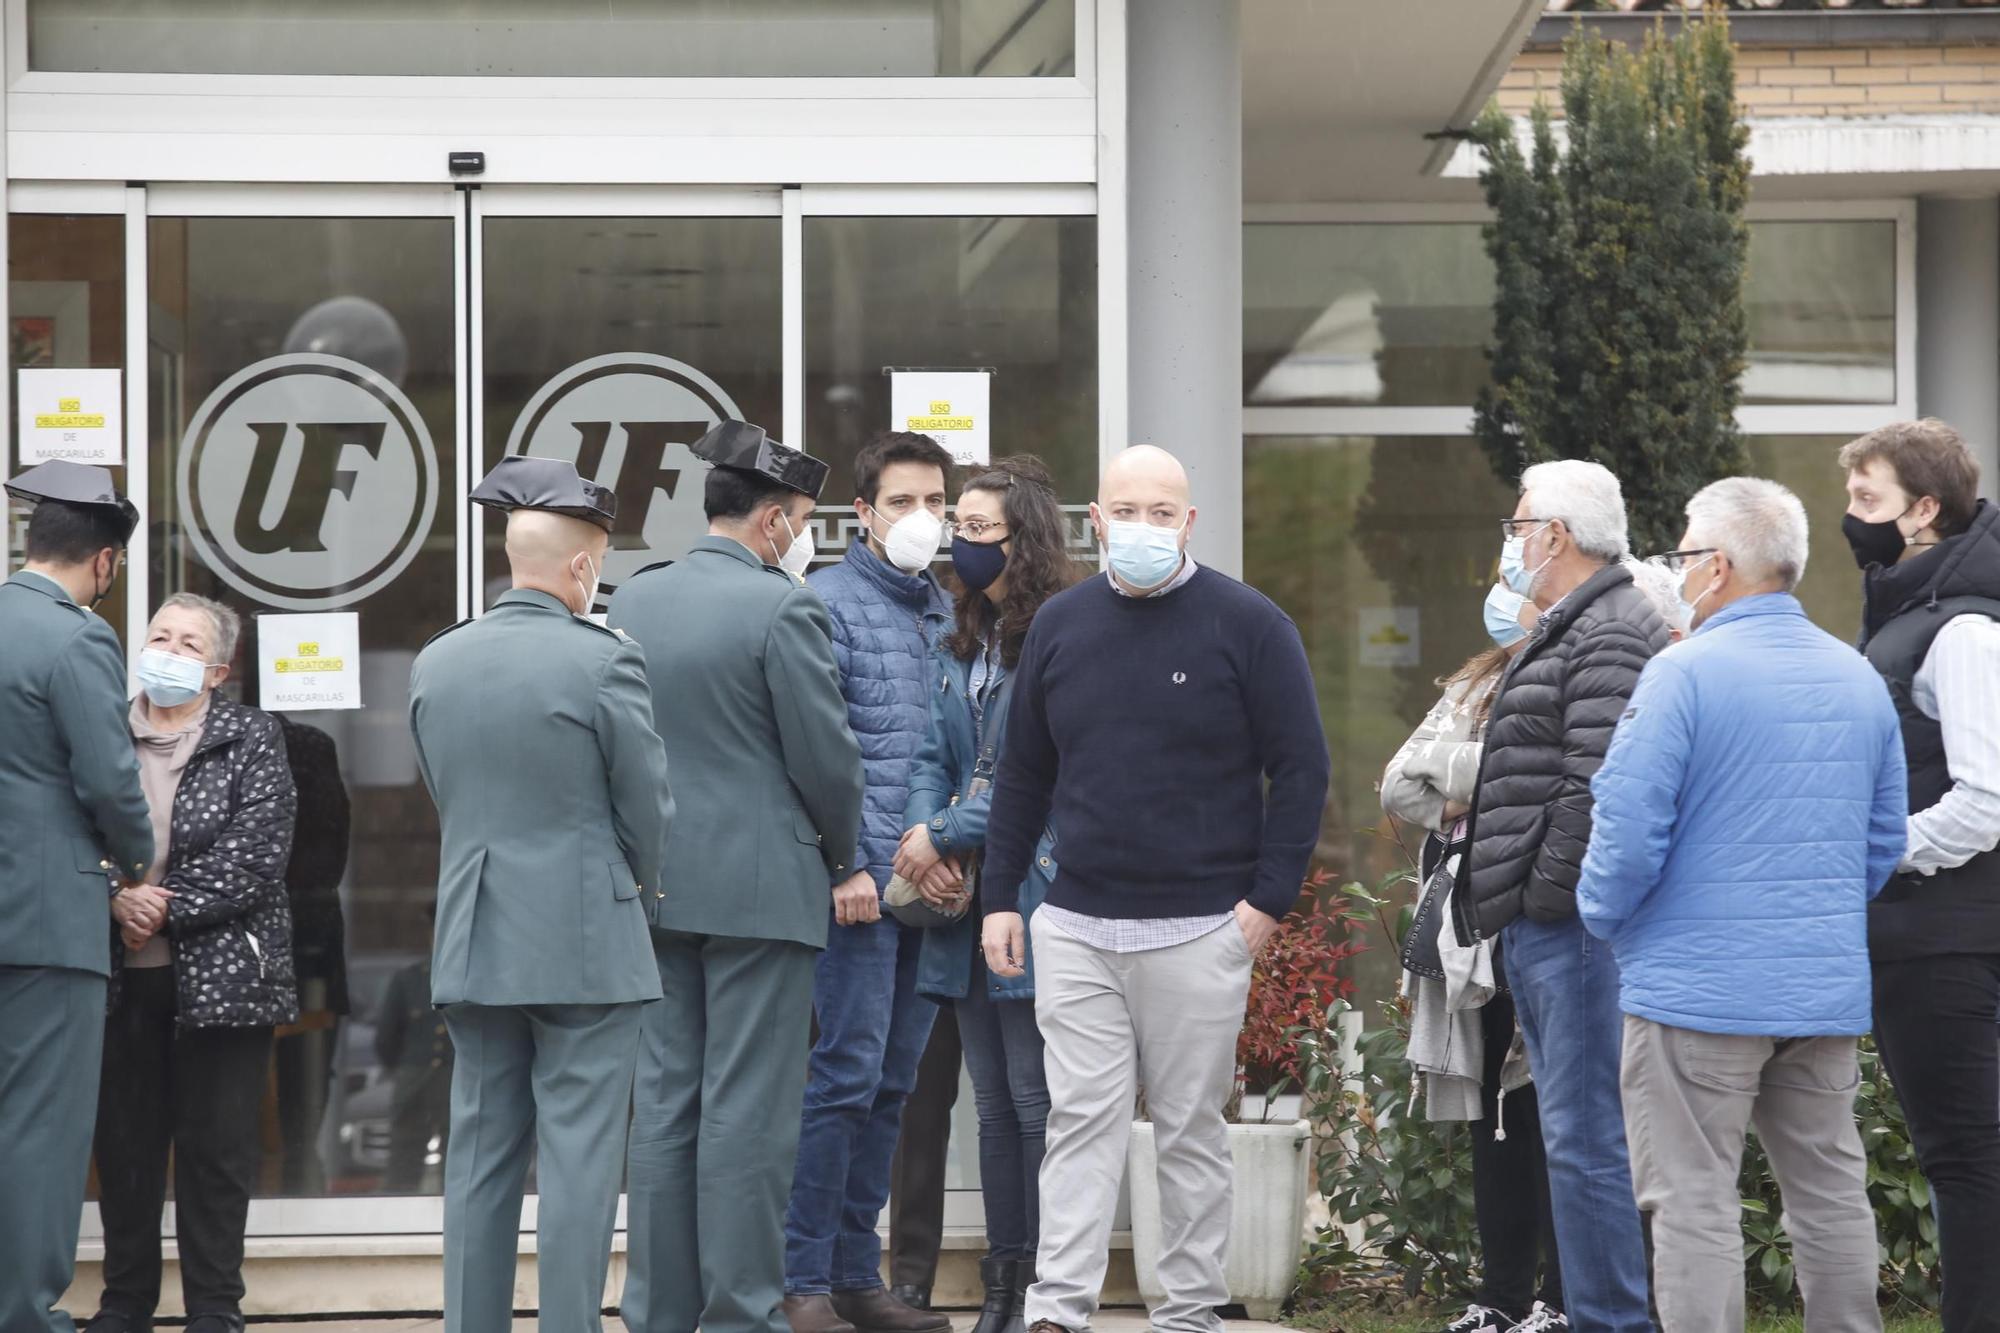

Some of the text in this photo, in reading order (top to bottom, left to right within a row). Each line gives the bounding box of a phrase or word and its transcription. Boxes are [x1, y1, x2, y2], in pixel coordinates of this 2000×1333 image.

[59, 400, 81, 411] USO
[929, 403, 951, 413] USO
[35, 416, 105, 427] OBLIGATORIO
[906, 419, 974, 429] OBLIGATORIO
[63, 432, 77, 441] DE
[934, 434, 947, 443] DE
[35, 449, 105, 458] MASCARILLAS
[234, 422, 387, 555] UF
[298, 643, 320, 655] USO
[275, 660, 344, 671] OBLIGATORIO
[303, 676, 317, 686] DE
[275, 692, 345, 702] MASCARILLAS
